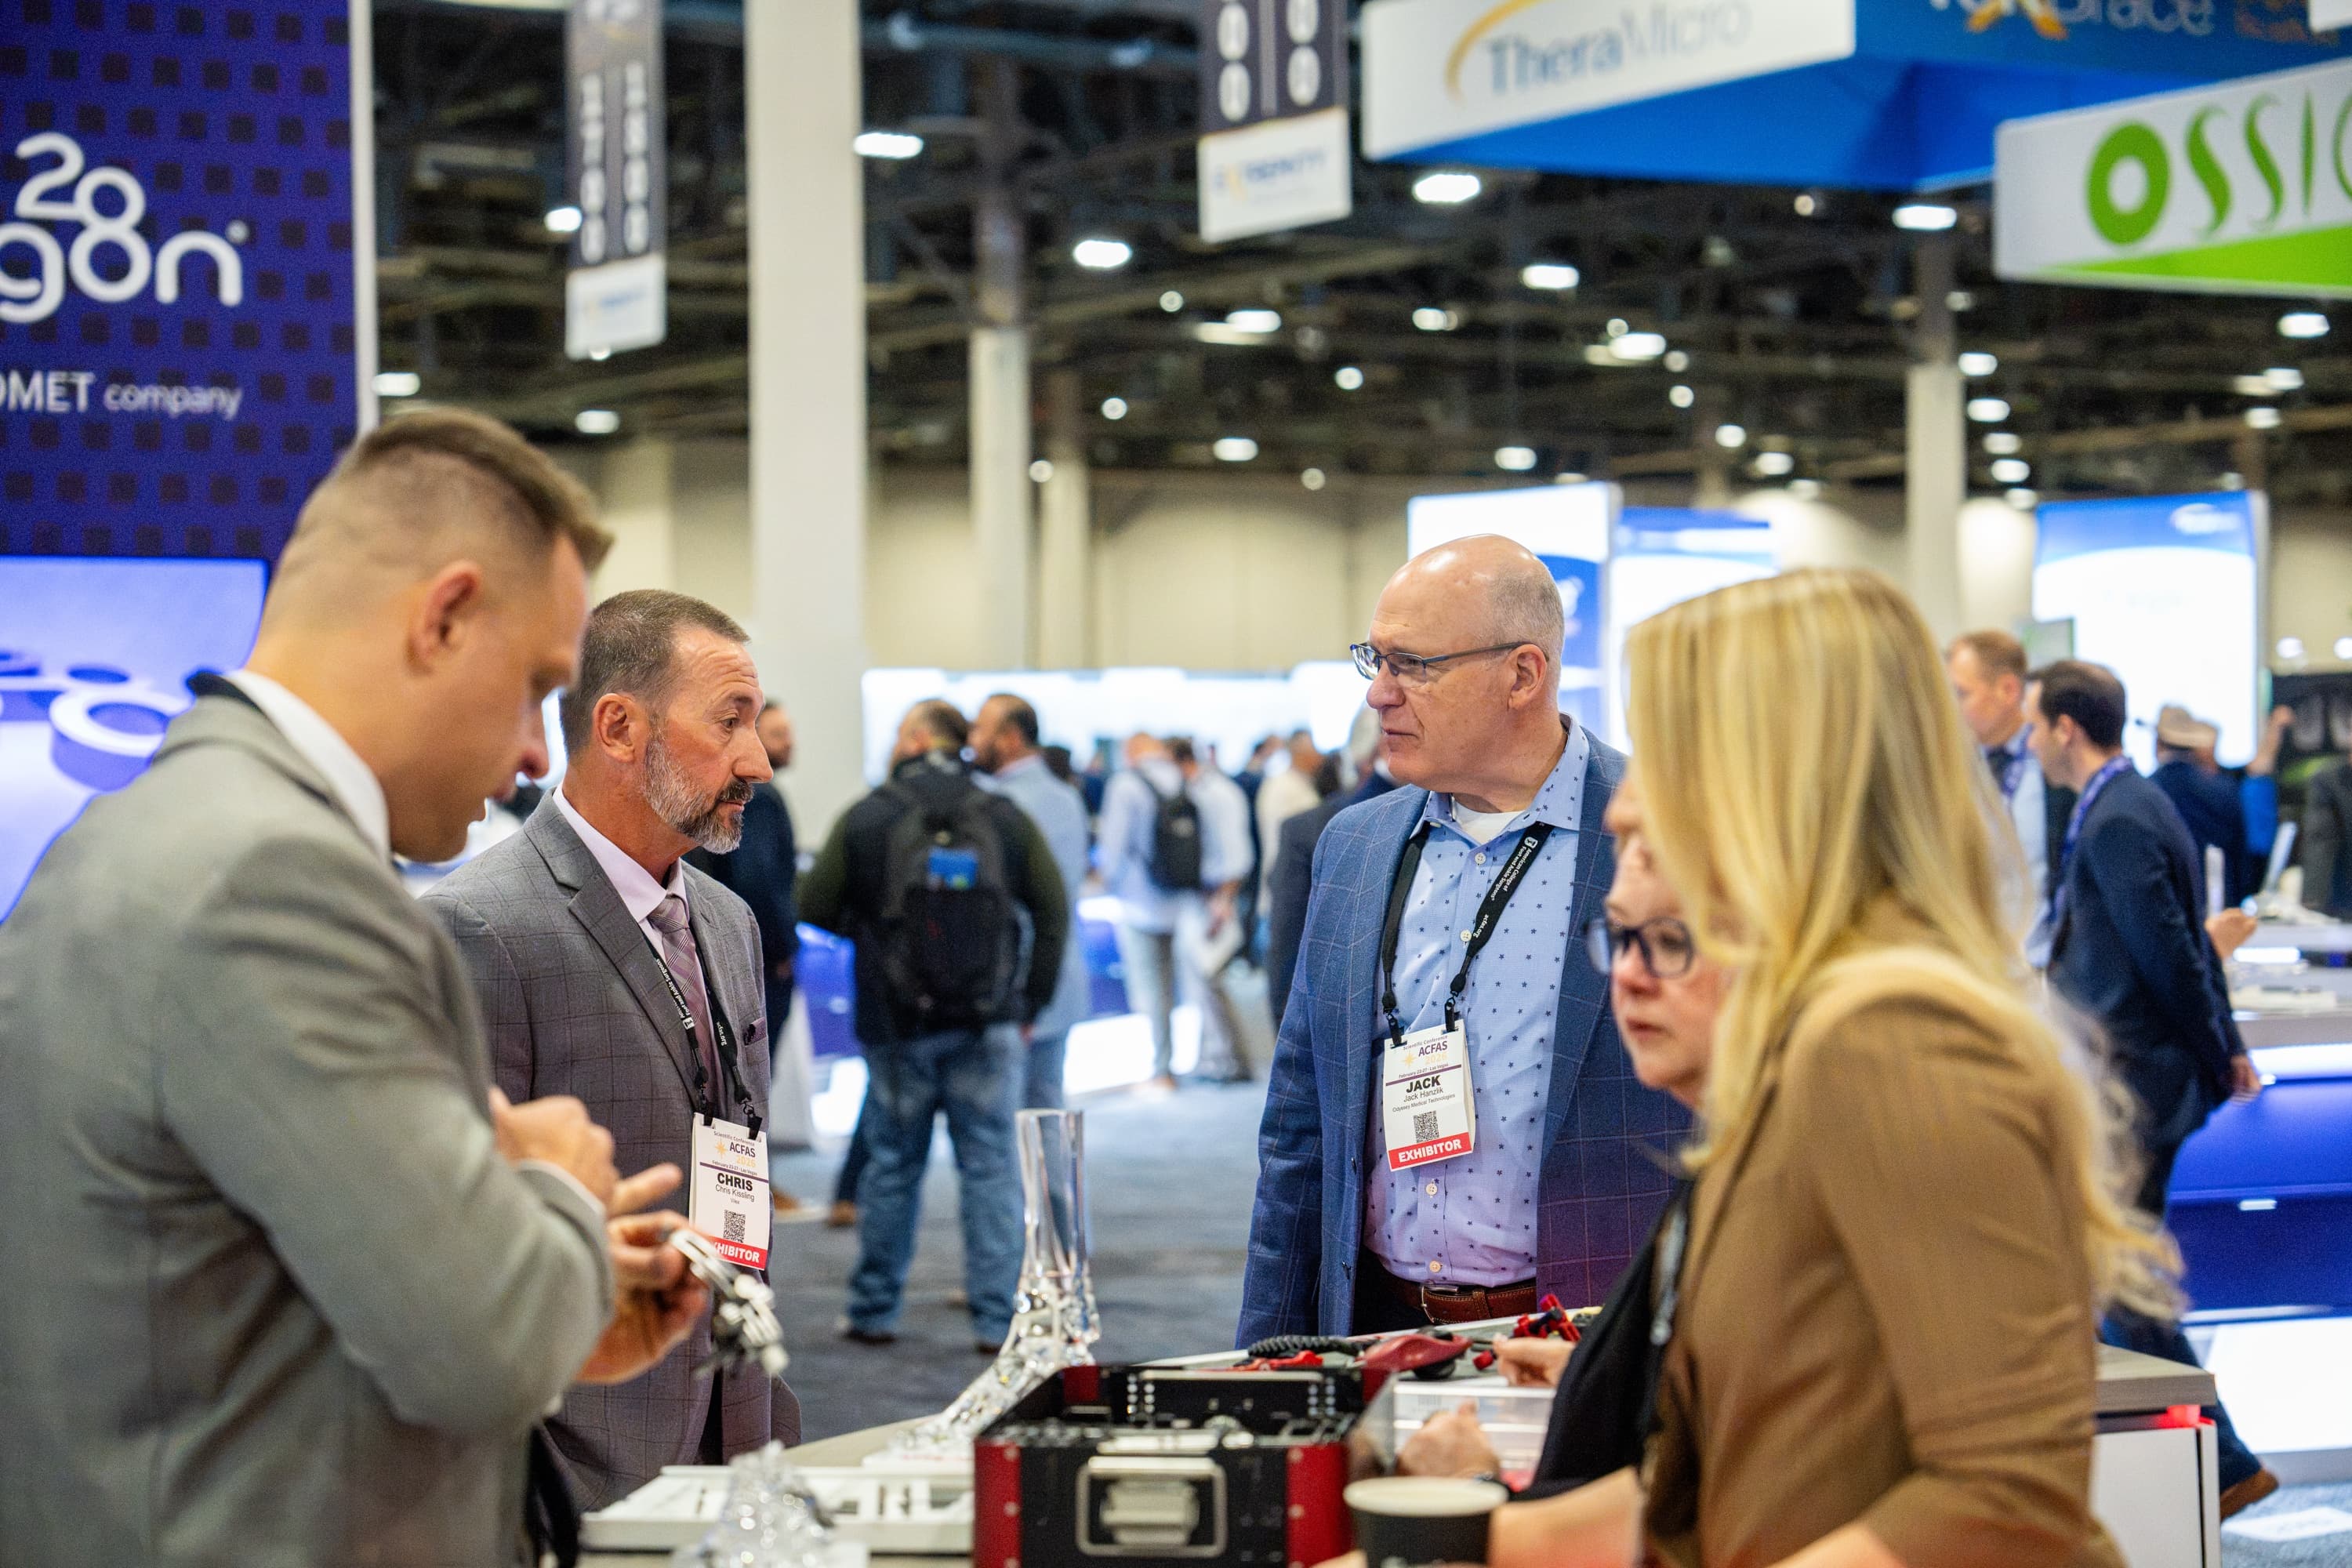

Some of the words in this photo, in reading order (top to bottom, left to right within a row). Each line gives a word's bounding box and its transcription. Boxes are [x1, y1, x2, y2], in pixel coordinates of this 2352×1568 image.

[0, 369, 96, 414] MET
[103, 383, 242, 421] company
[1517, 848, 1532, 870] American
[1473, 914, 1489, 938] acfas.org
[1403, 1040, 1422, 1051] Scientific
[1423, 1035, 1448, 1045] Conference
[1418, 1040, 1448, 1057] ACFAS
[1425, 1053, 1448, 1065] 2026
[1406, 1075, 1441, 1093] JACK
[1392, 1103, 1410, 1112] Odyssey
[1411, 1099, 1428, 1109] Medical
[1428, 1093, 1456, 1104] Technologies
[1403, 1094, 1418, 1102] Jack
[1420, 1087, 1443, 1098] Hanzlik
[713, 1131, 732, 1141] Scientific
[733, 1137, 755, 1146] Conference
[729, 1142, 756, 1158] ACFAS
[1398, 1139, 1462, 1163] EXHIBITOR
[736, 1156, 757, 1167] 2026
[717, 1172, 753, 1191] CHRIS
[716, 1184, 731, 1195] Chris
[732, 1189, 755, 1203] Kissling
[714, 1242, 760, 1264] HIBITOR
